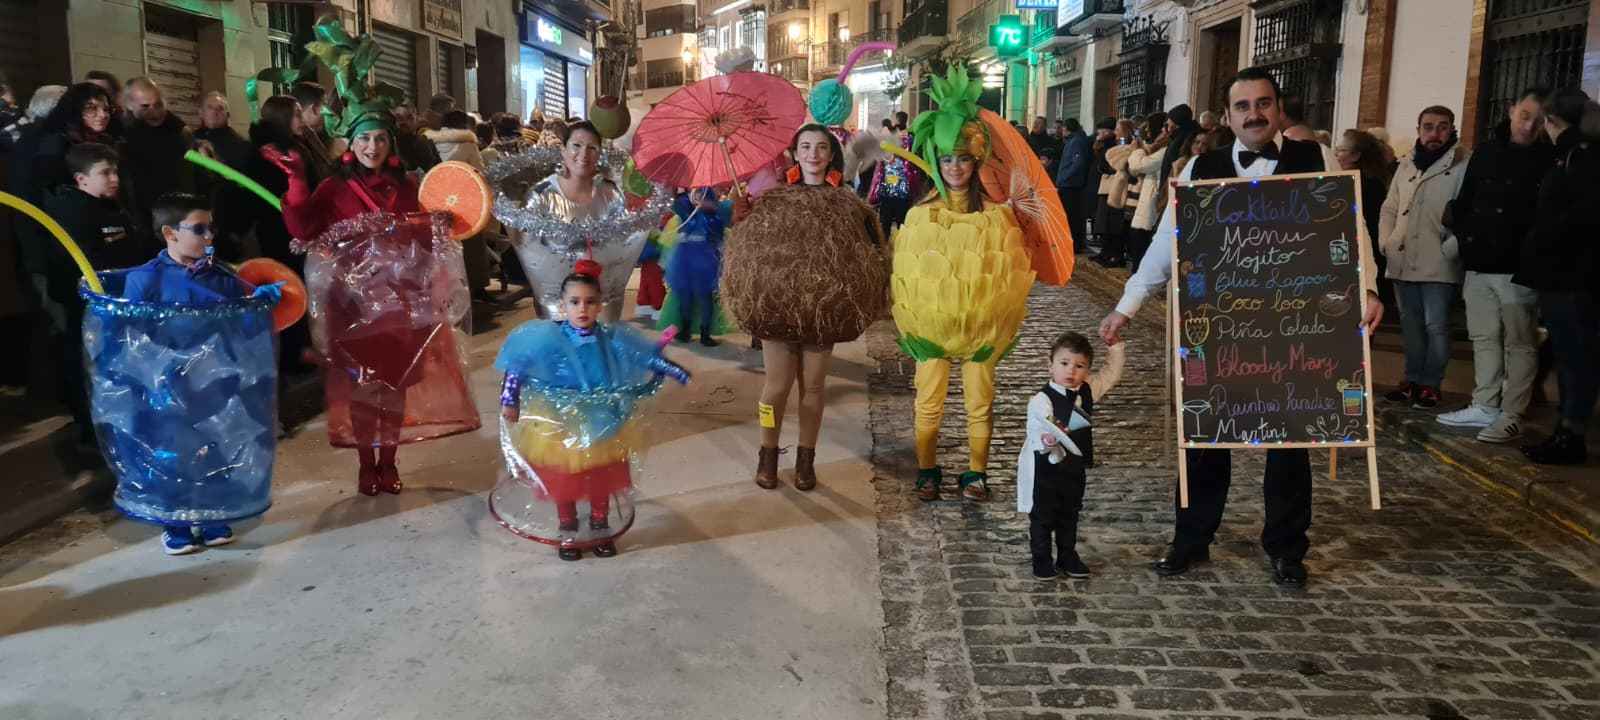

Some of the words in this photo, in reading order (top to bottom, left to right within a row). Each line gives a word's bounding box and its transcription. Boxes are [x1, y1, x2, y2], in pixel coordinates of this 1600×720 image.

[1215, 187, 1310, 223] Cocktails
[1220, 226, 1317, 252] Menu
[1212, 246, 1306, 274] Mojito
[1215, 271, 1261, 292] Blue
[1265, 267, 1337, 296] Lagoon
[1216, 291, 1265, 313] Coco
[1211, 314, 1273, 340] Piña
[1279, 311, 1336, 336] Colada
[1215, 342, 1287, 384] Bloody
[1288, 341, 1339, 379] Mary
[1215, 416, 1288, 443] Martini
